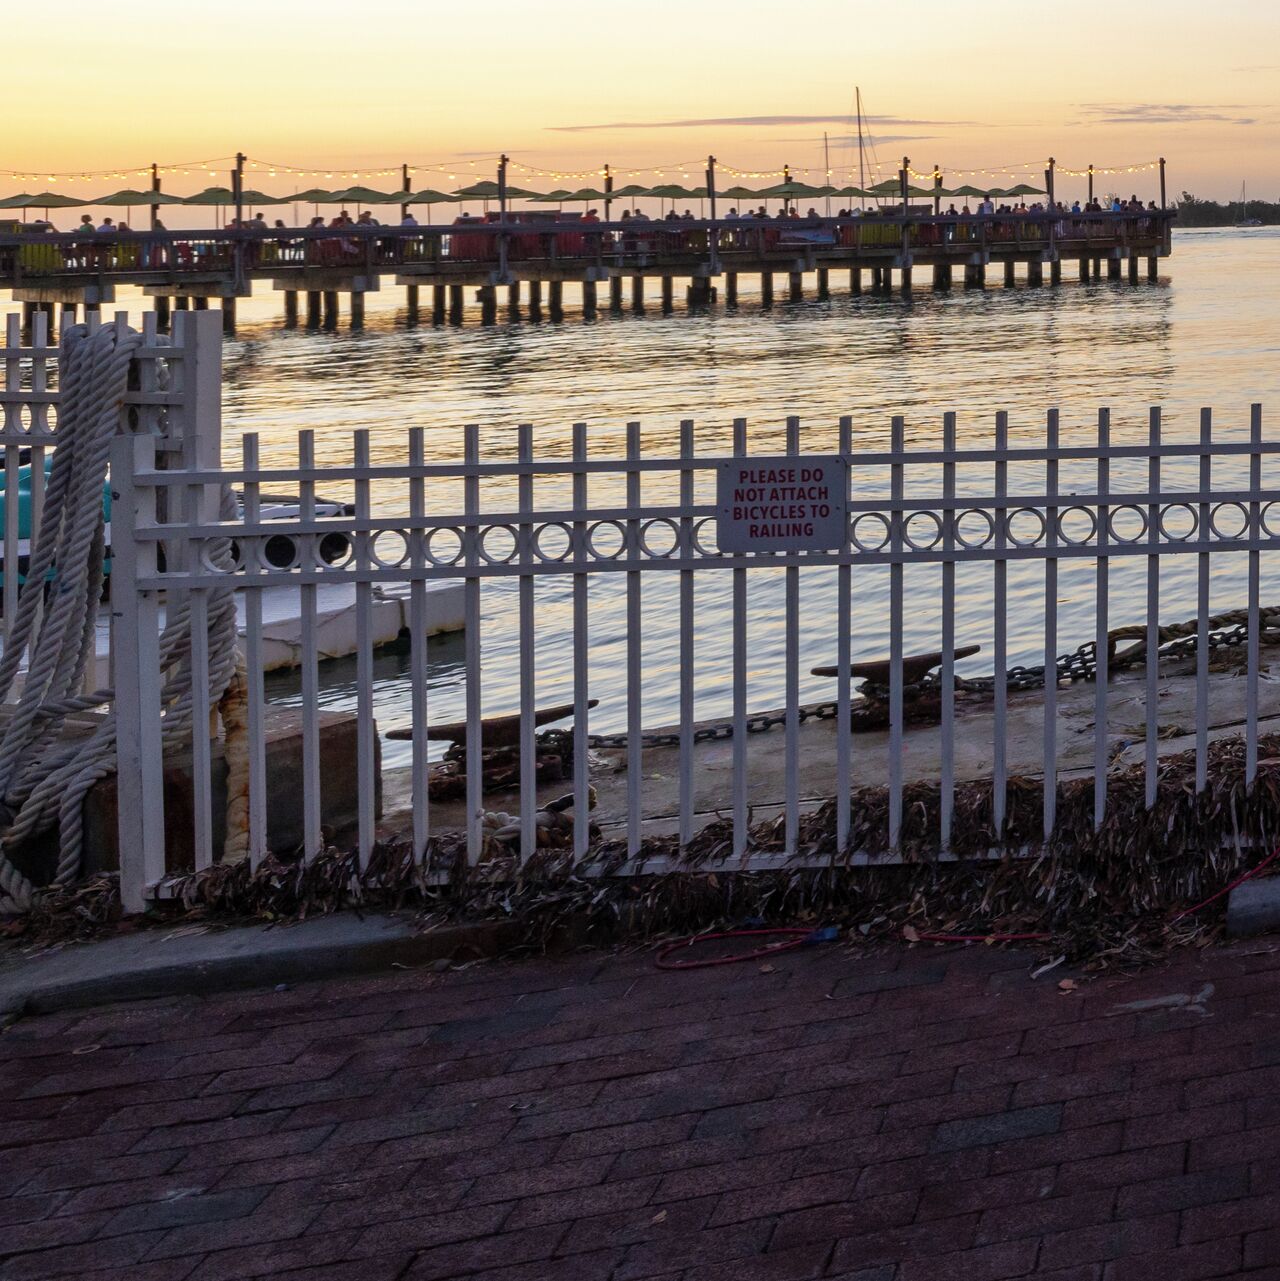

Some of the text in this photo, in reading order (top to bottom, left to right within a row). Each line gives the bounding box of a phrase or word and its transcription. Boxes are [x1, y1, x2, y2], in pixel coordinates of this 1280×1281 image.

[739, 469, 823, 483] PLEASE DO
[734, 487, 828, 501] NOT ATTACH
[734, 505, 829, 520] BICYCLES TO
[750, 523, 813, 538] RAILING
